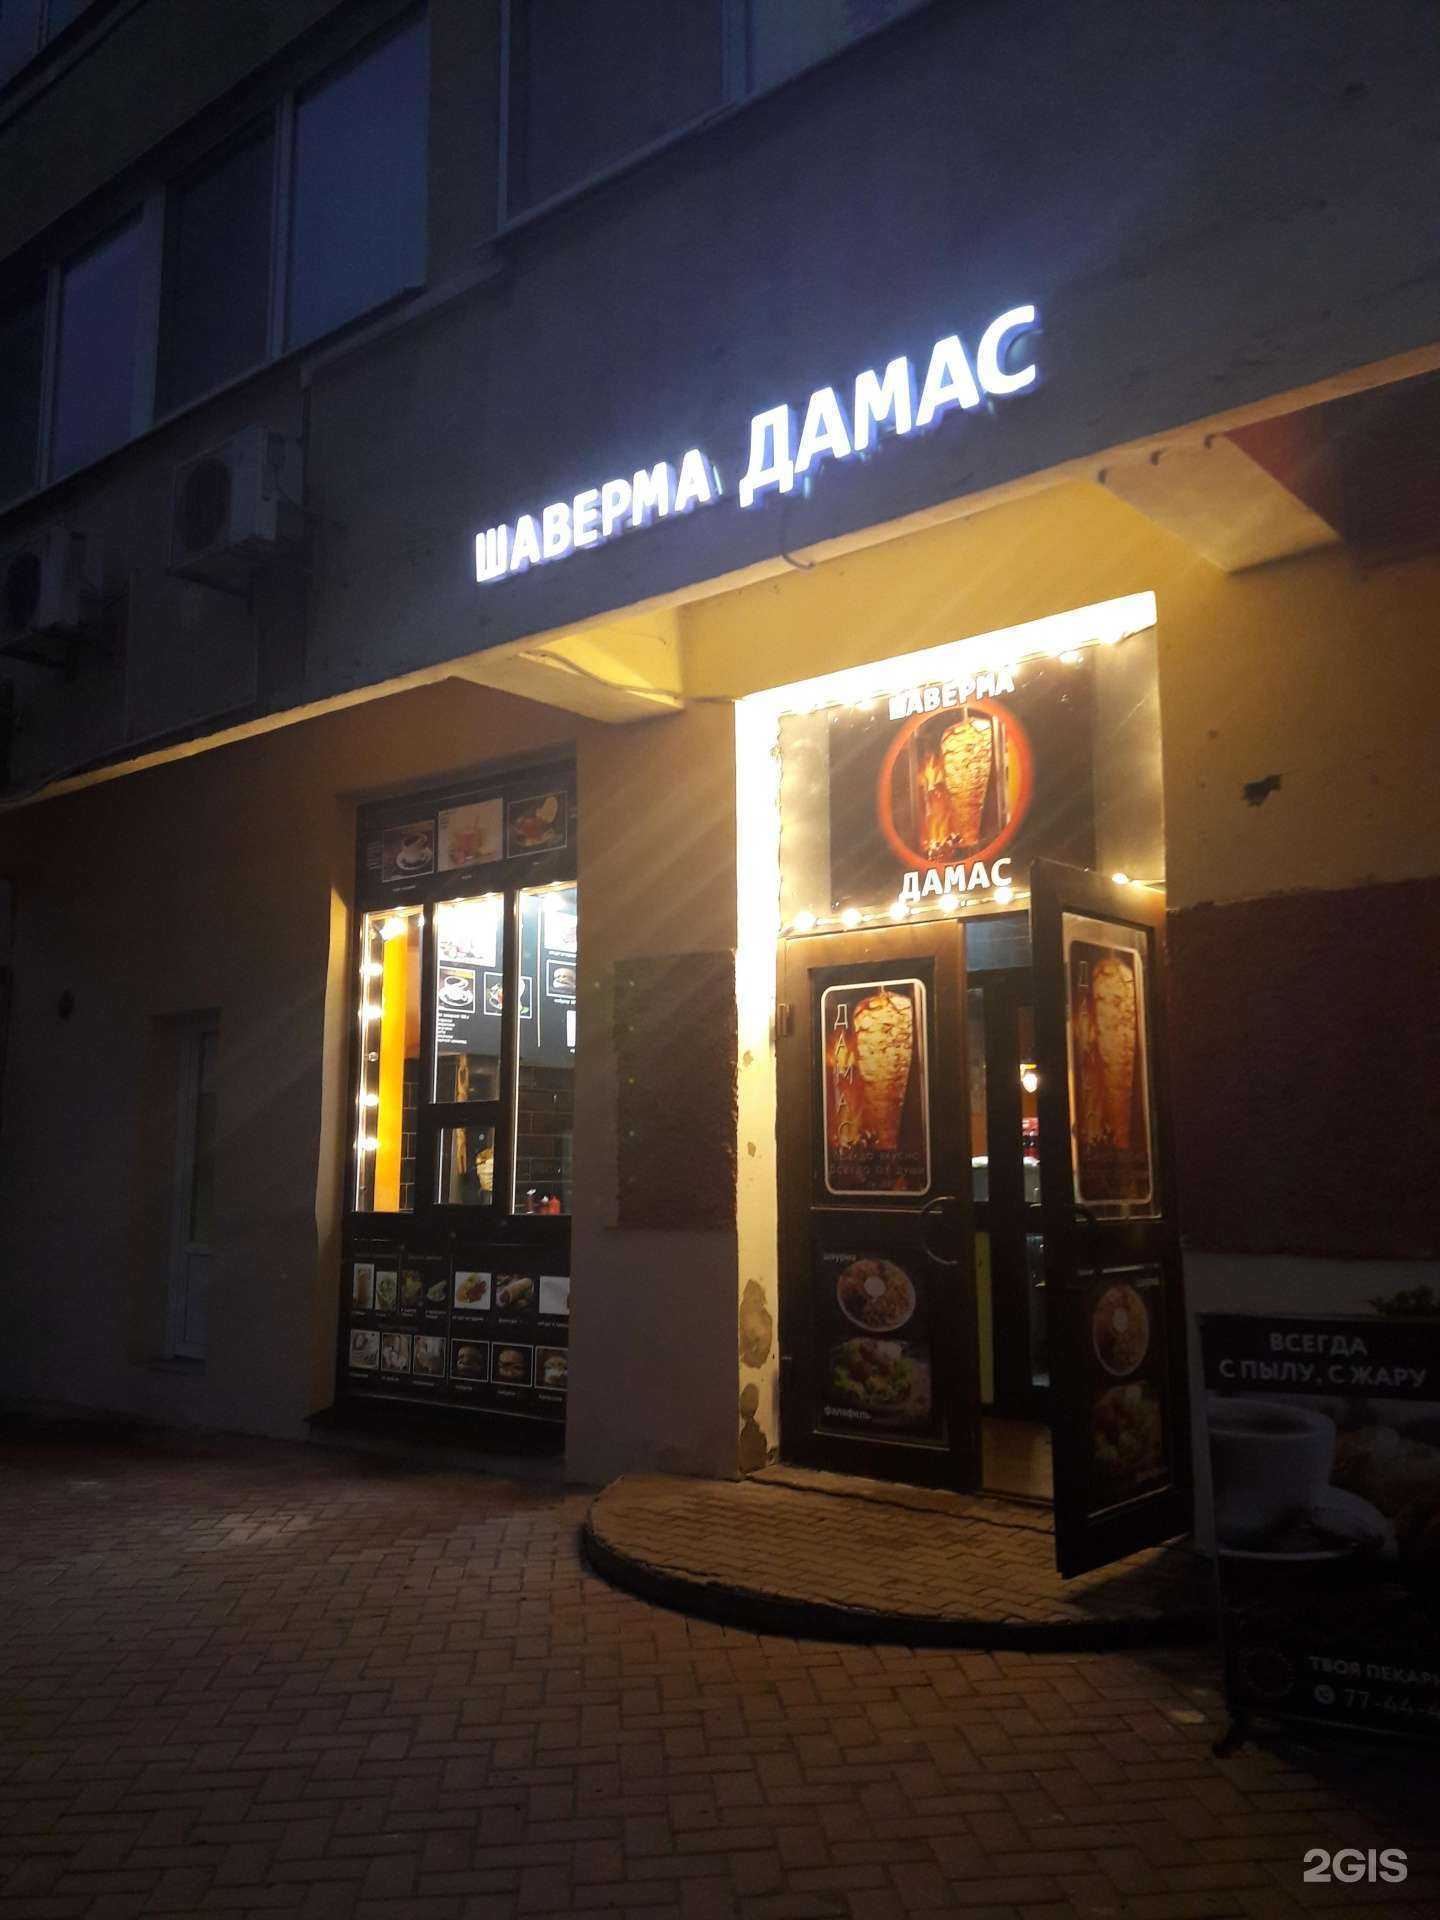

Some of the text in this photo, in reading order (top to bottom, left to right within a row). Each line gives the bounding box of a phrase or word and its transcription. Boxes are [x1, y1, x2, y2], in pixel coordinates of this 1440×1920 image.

[474, 304, 1038, 585] ШАВЕРМА ДАМАС
[888, 668, 1016, 720] ШАВЕРМА
[898, 856, 1013, 906] ДАМАС
[1268, 1331, 1369, 1357] ВСЕГДА
[1218, 1358, 1429, 1389] С ПЫЛУ, С ЖАРУ
[1307, 1656, 1361, 1680] ТВОЯ
